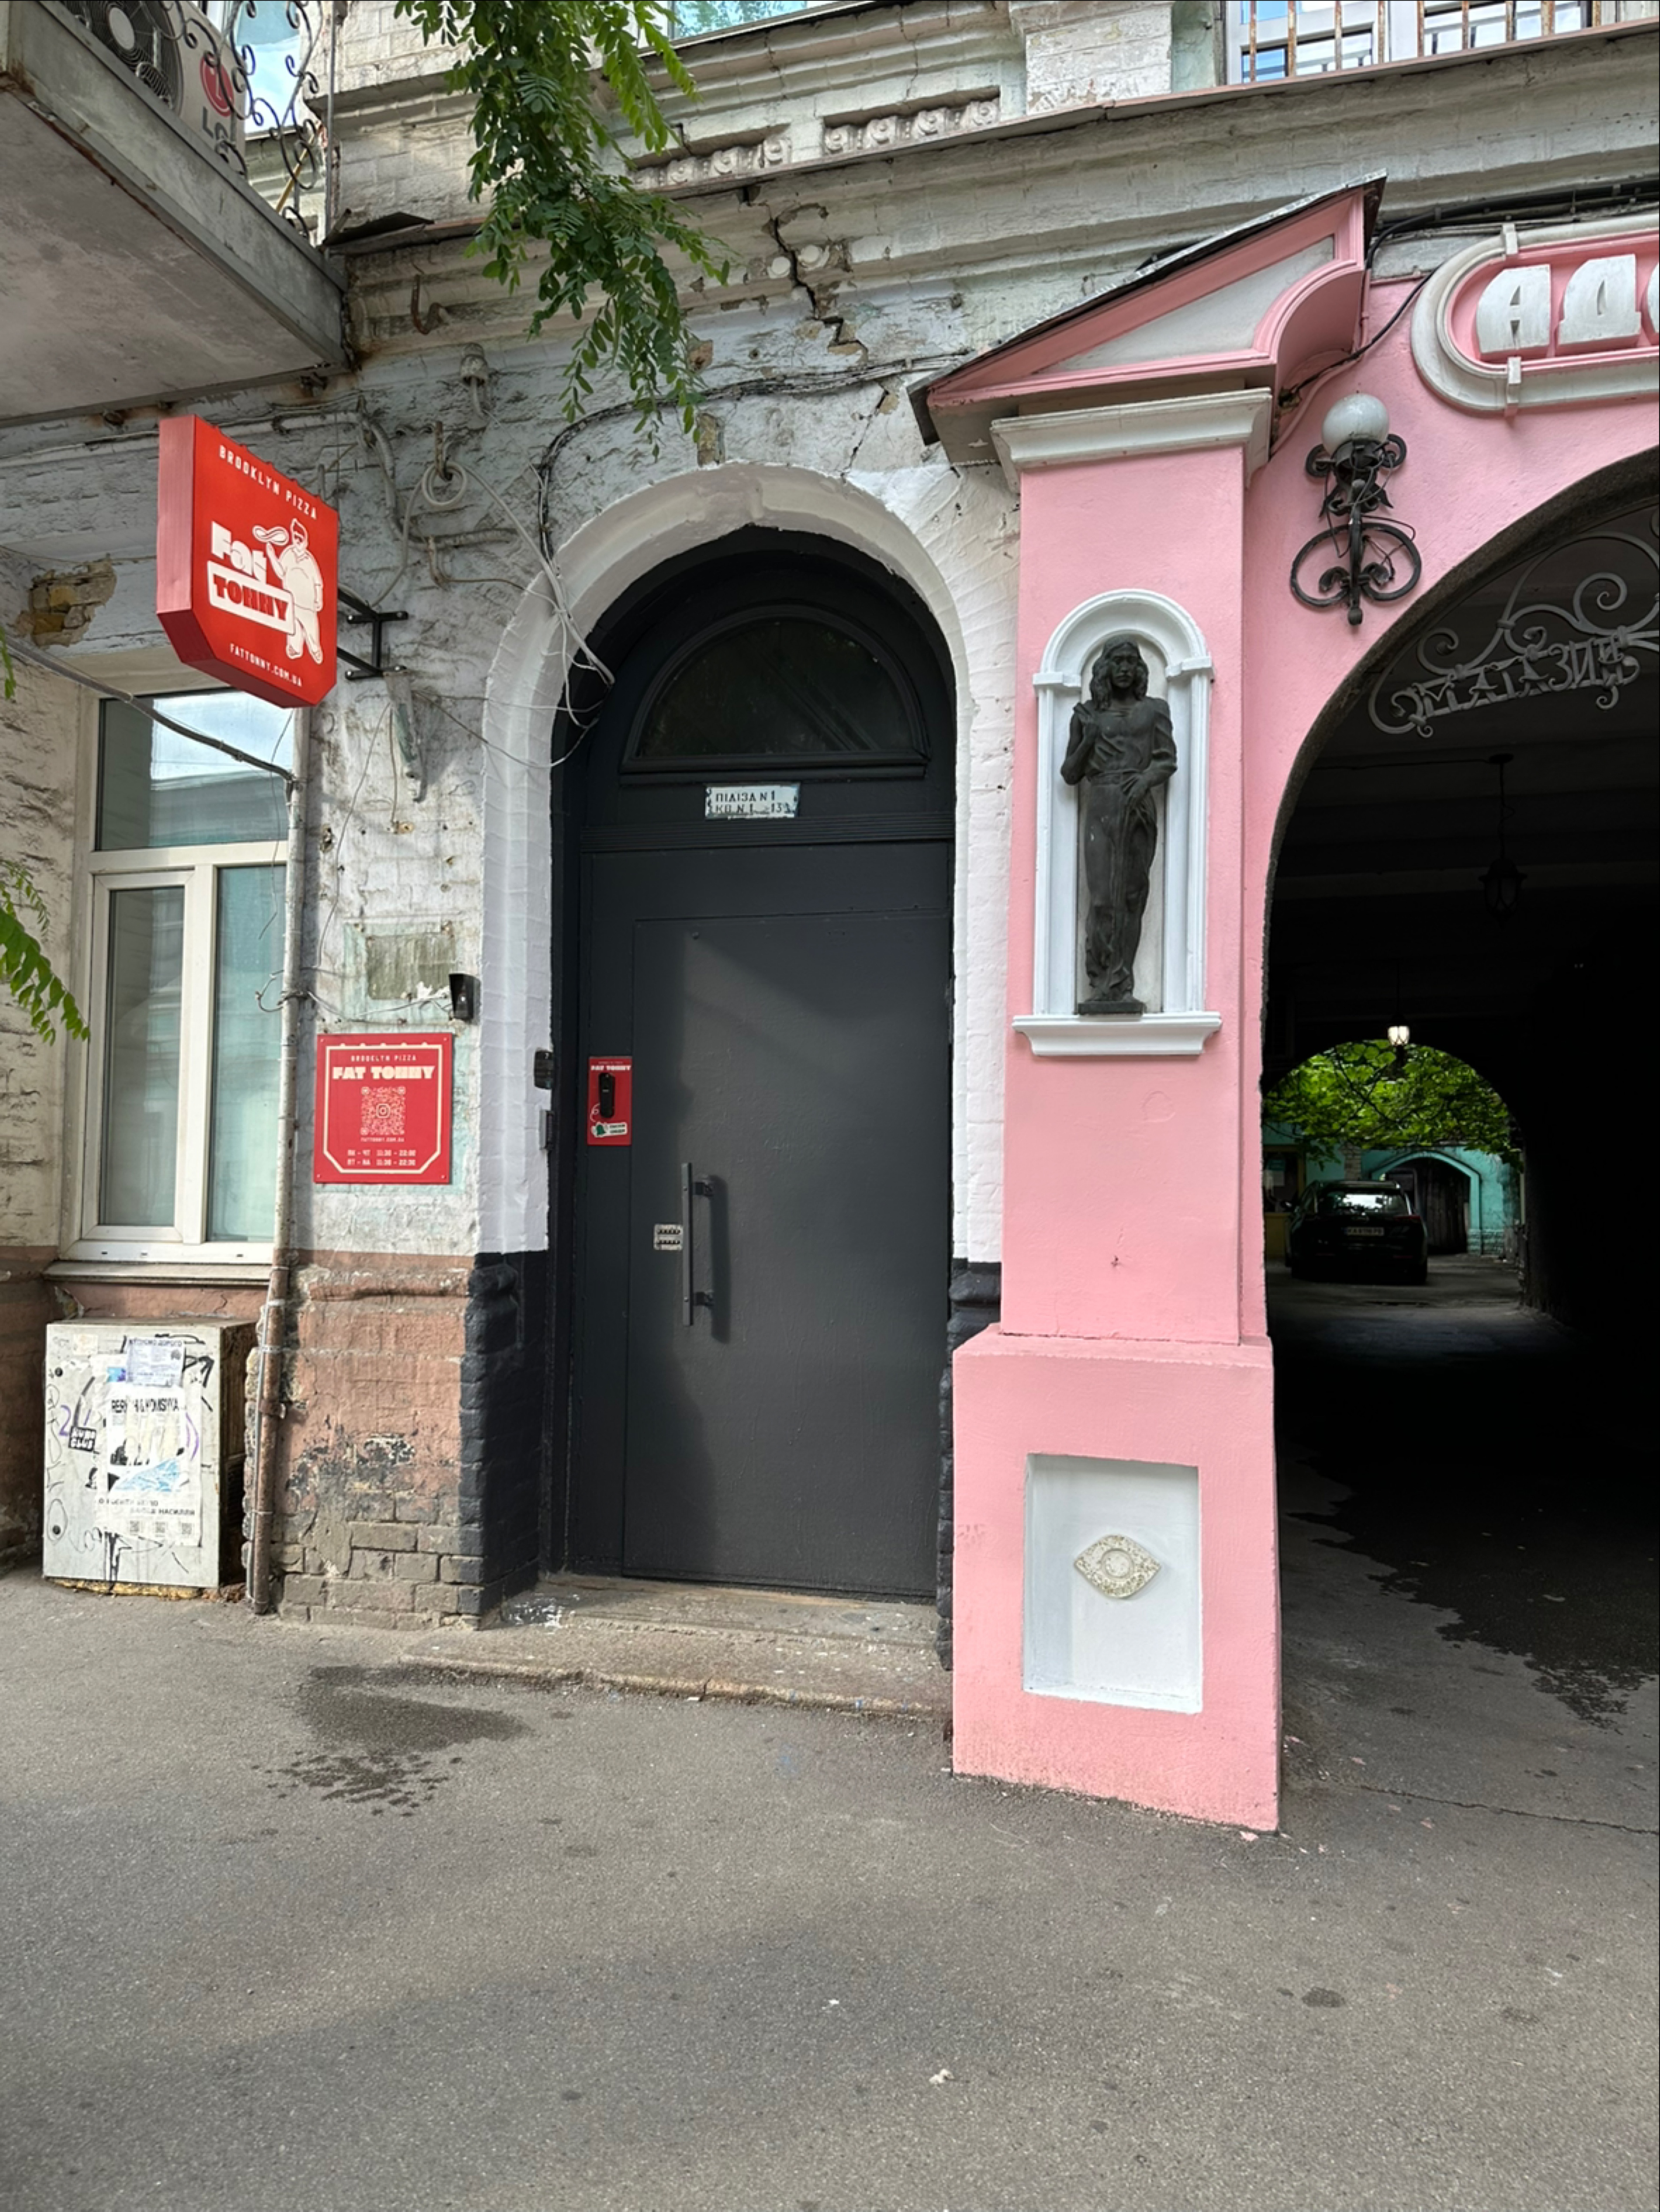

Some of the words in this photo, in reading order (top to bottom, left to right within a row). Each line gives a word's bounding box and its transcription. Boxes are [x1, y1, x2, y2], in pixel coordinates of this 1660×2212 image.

[1476, 254, 1659, 355] АД
[219, 445, 280, 495] BROOKLYN
[286, 490, 317, 520] PIZZA
[211, 521, 267, 585] Fat
[213, 580, 289, 622] TONNY
[229, 642, 303, 688] FATTONNY.COM.UA
[332, 1066, 366, 1080] FAT
[370, 1065, 435, 1080] TONNY
